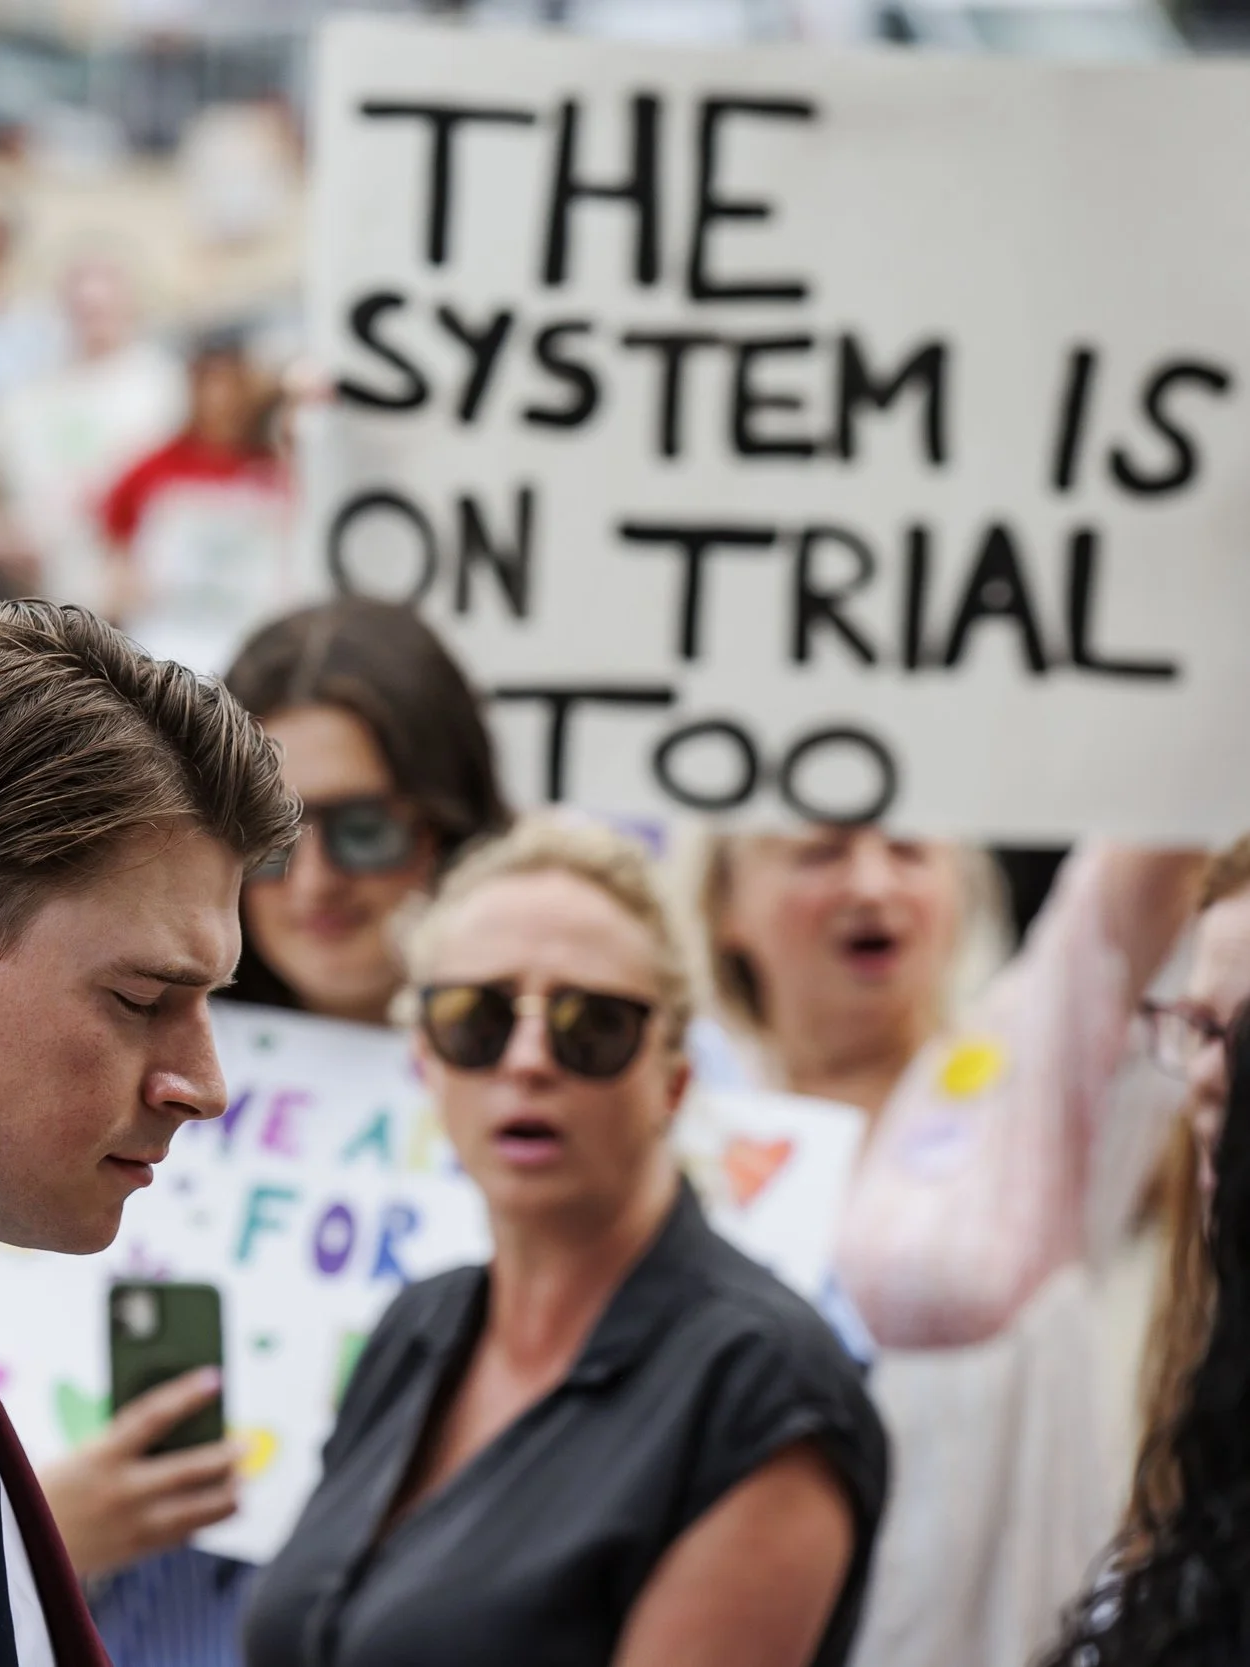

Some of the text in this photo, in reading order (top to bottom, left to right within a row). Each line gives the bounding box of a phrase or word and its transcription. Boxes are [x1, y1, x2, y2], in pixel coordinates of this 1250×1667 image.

[358, 90, 820, 306] THE
[332, 290, 1236, 503] SYSTEM IS
[326, 484, 1182, 685] ON TRIAL
[495, 686, 900, 826] TOO
[232, 1184, 421, 1286] FOR
